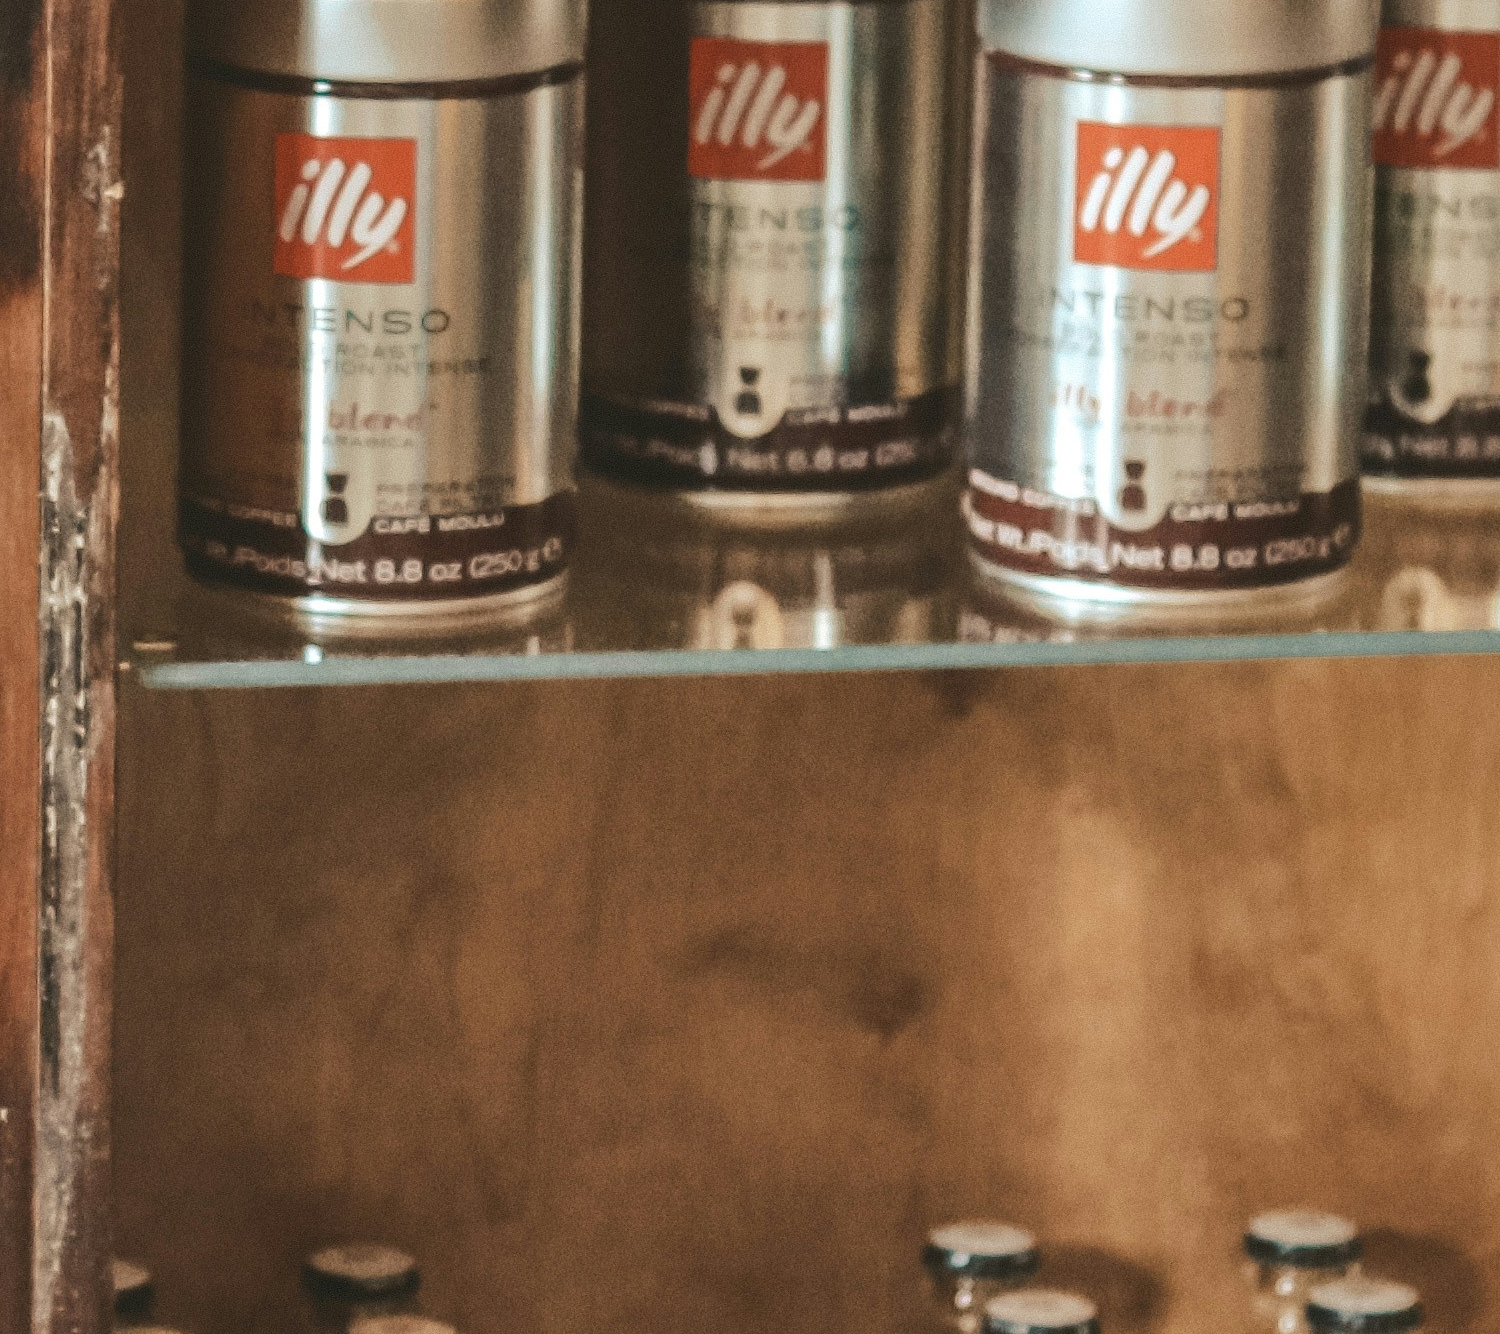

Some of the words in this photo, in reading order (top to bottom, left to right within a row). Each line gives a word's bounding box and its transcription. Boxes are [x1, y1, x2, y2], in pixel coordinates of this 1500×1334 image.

[695, 63, 822, 169] illy
[280, 156, 408, 271] illy
[698, 202, 861, 234] TENSO
[1080, 144, 1211, 258] illy
[240, 302, 453, 336] NTENSO
[1046, 287, 1251, 323] NTENSO
[374, 512, 432, 534] CAFÉ
[316, 555, 368, 585] Net
[373, 558, 423, 585] 8.8
[430, 563, 464, 584] oz
[1110, 542, 1165, 571] Net
[1169, 543, 1221, 572] 8.8
